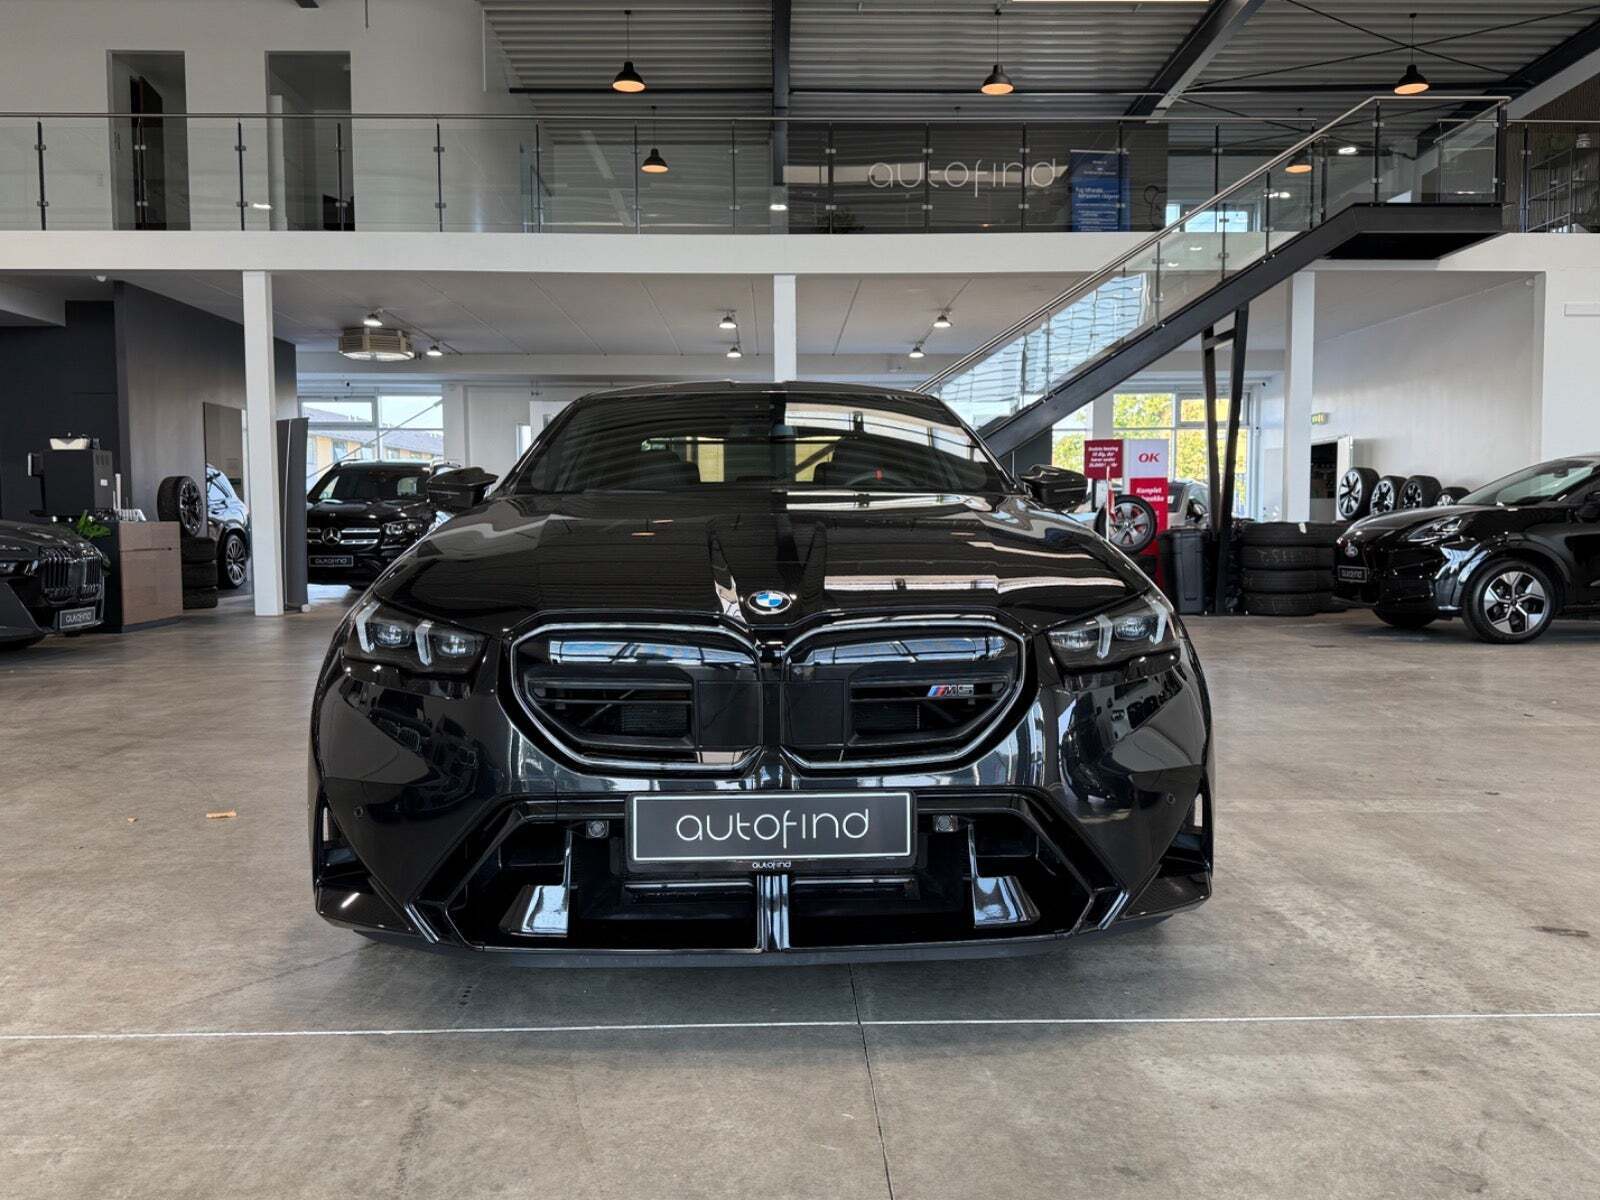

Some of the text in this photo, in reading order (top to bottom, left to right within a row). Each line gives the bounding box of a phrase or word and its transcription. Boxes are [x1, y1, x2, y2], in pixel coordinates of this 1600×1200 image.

[868, 158, 1057, 198] autofind
[1138, 452, 1160, 463] OK
[676, 808, 869, 848] autofind
[752, 859, 792, 870] autofind
